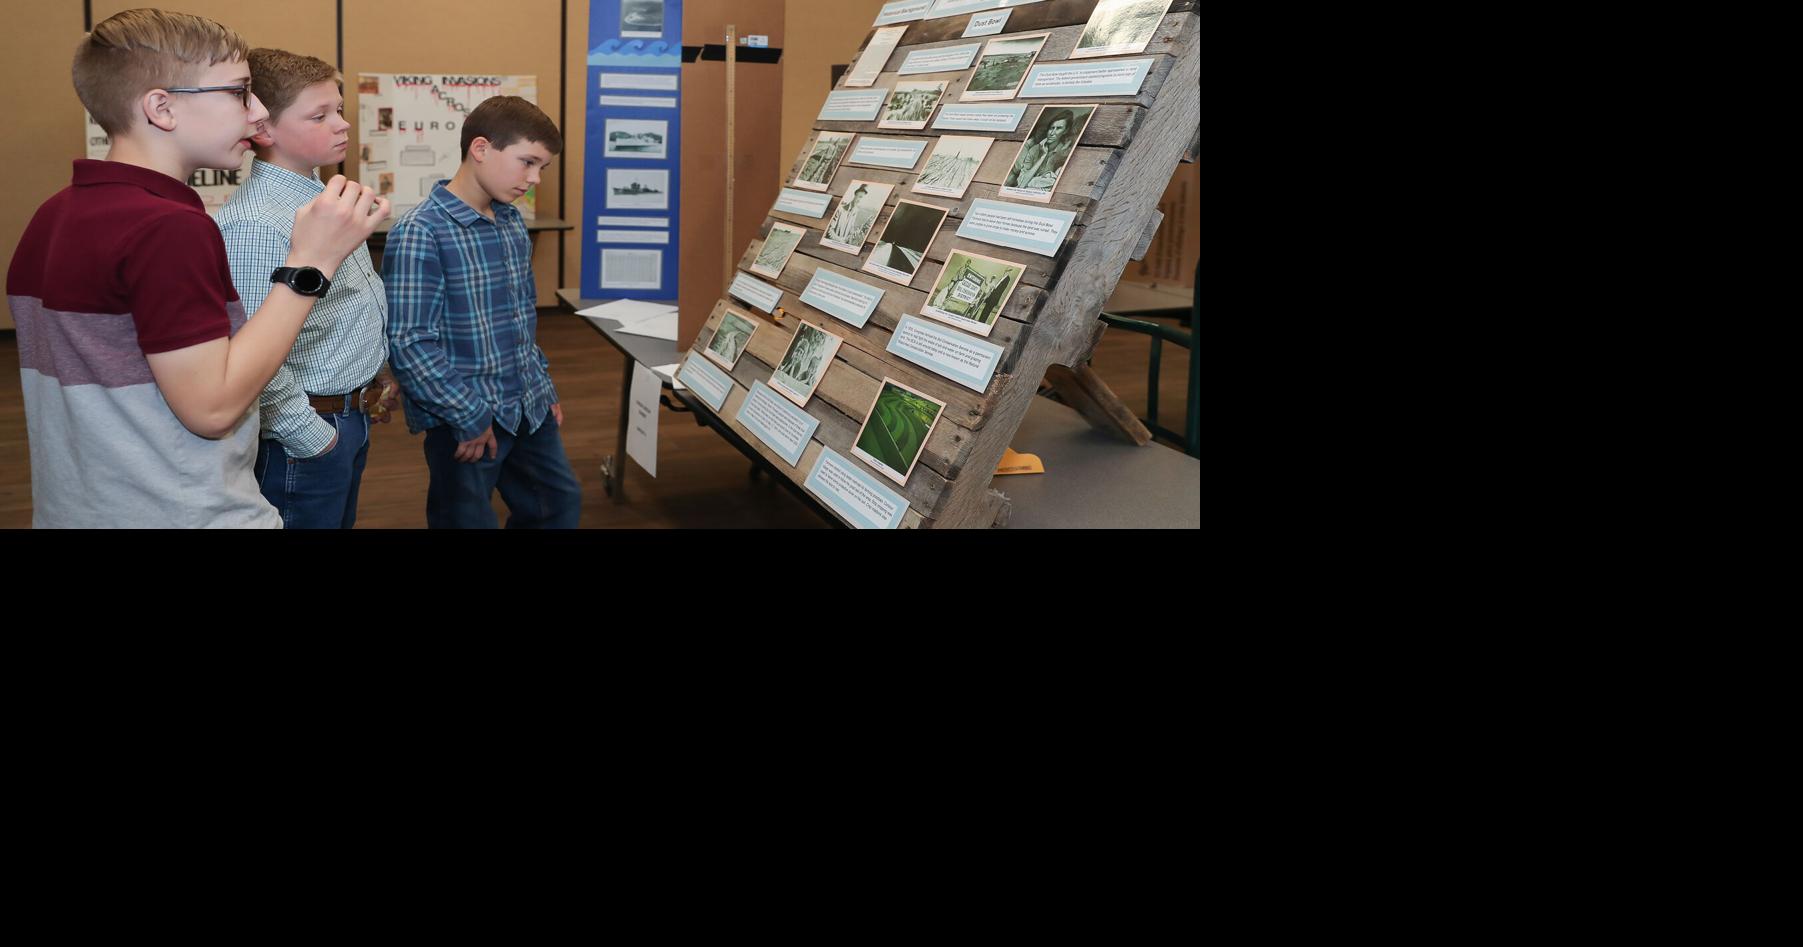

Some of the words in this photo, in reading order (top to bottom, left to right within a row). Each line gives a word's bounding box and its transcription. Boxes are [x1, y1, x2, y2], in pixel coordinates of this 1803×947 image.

[988, 17, 1003, 25] Bowl
[393, 76, 433, 87] VIKING
[442, 76, 501, 86] INVASIONS
[398, 121, 456, 131] EURO
[188, 169, 241, 187] ELINE
